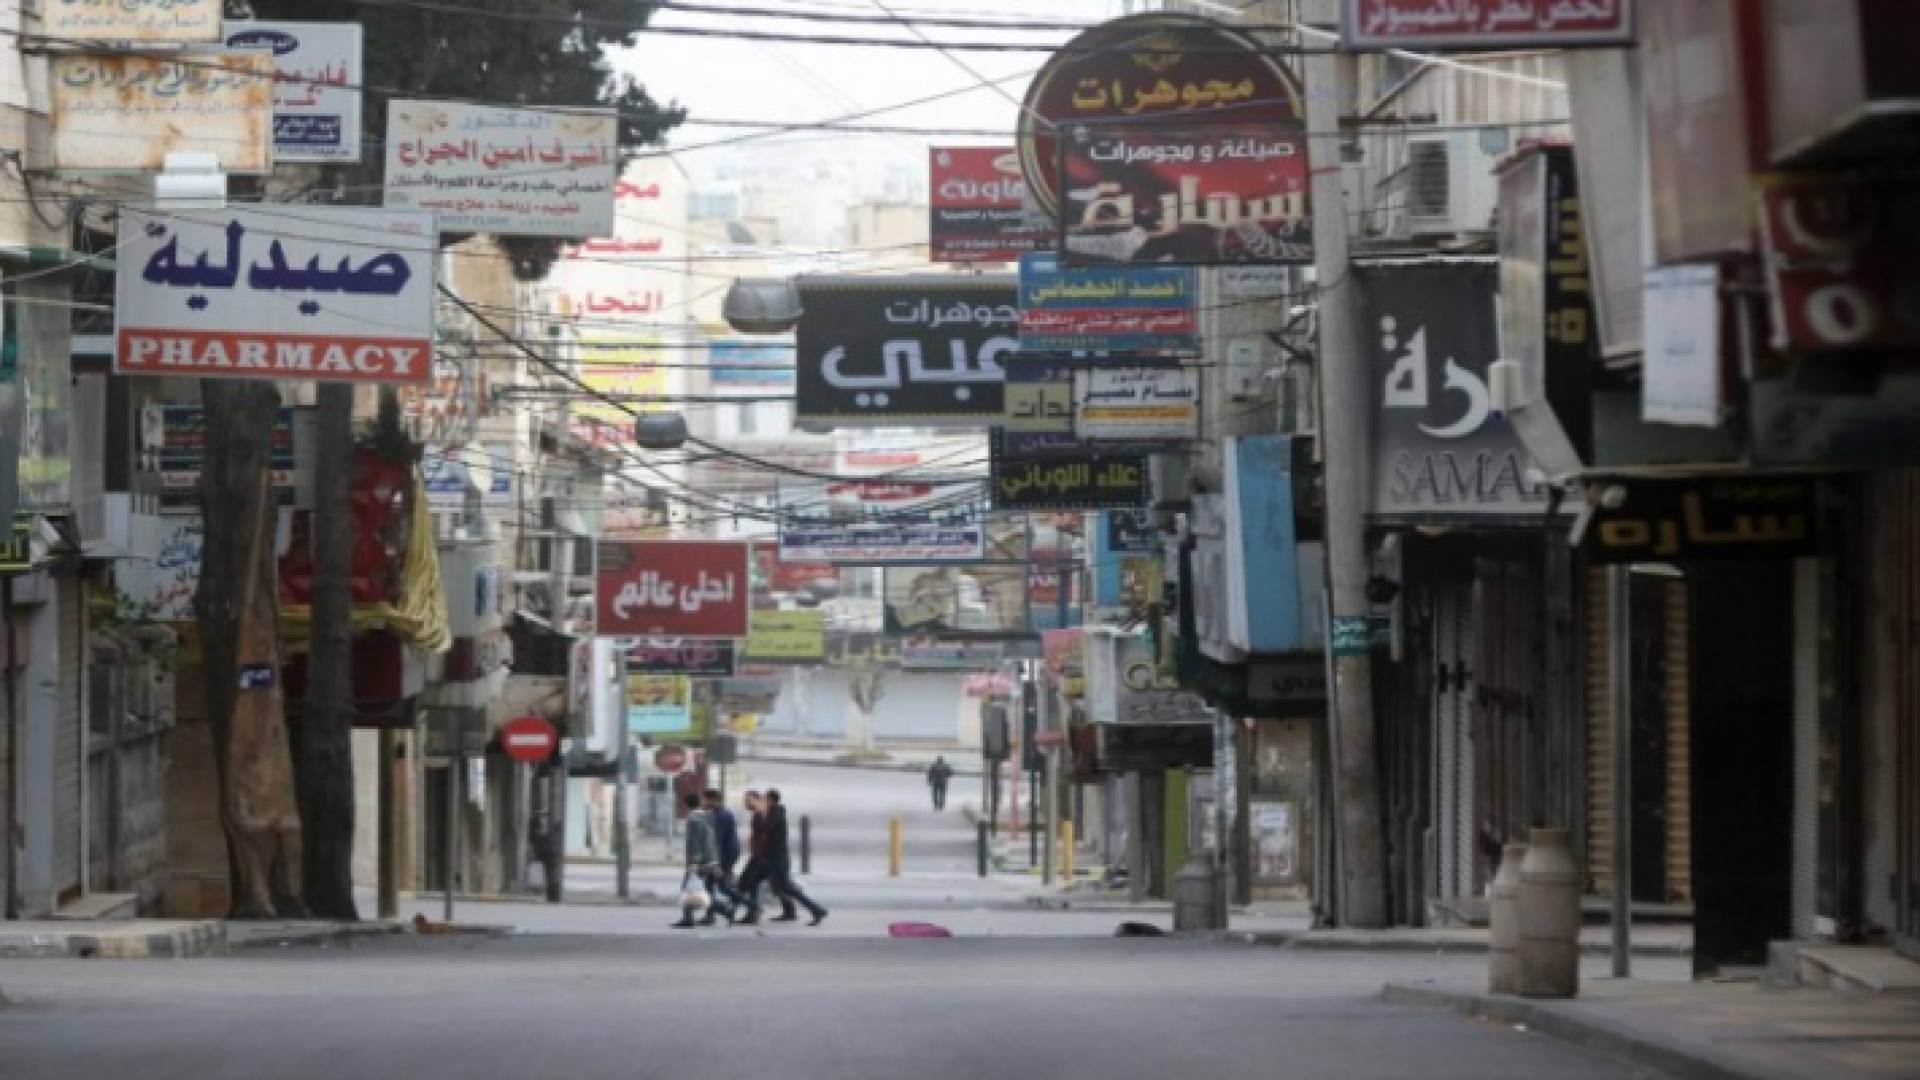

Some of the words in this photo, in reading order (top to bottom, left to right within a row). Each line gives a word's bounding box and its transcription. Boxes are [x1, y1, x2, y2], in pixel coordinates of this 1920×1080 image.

[1072, 78, 1254, 114] مجوهرات
[399, 136, 479, 167] الجراح
[1089, 137, 1195, 163] مجوهرات
[1220, 136, 1294, 160] صياغة
[143, 218, 411, 317] صيدلية
[885, 300, 1020, 329] جوهرات
[127, 336, 421, 374] PHARMACY
[820, 336, 1019, 408] عبي
[612, 570, 676, 620] عالم
